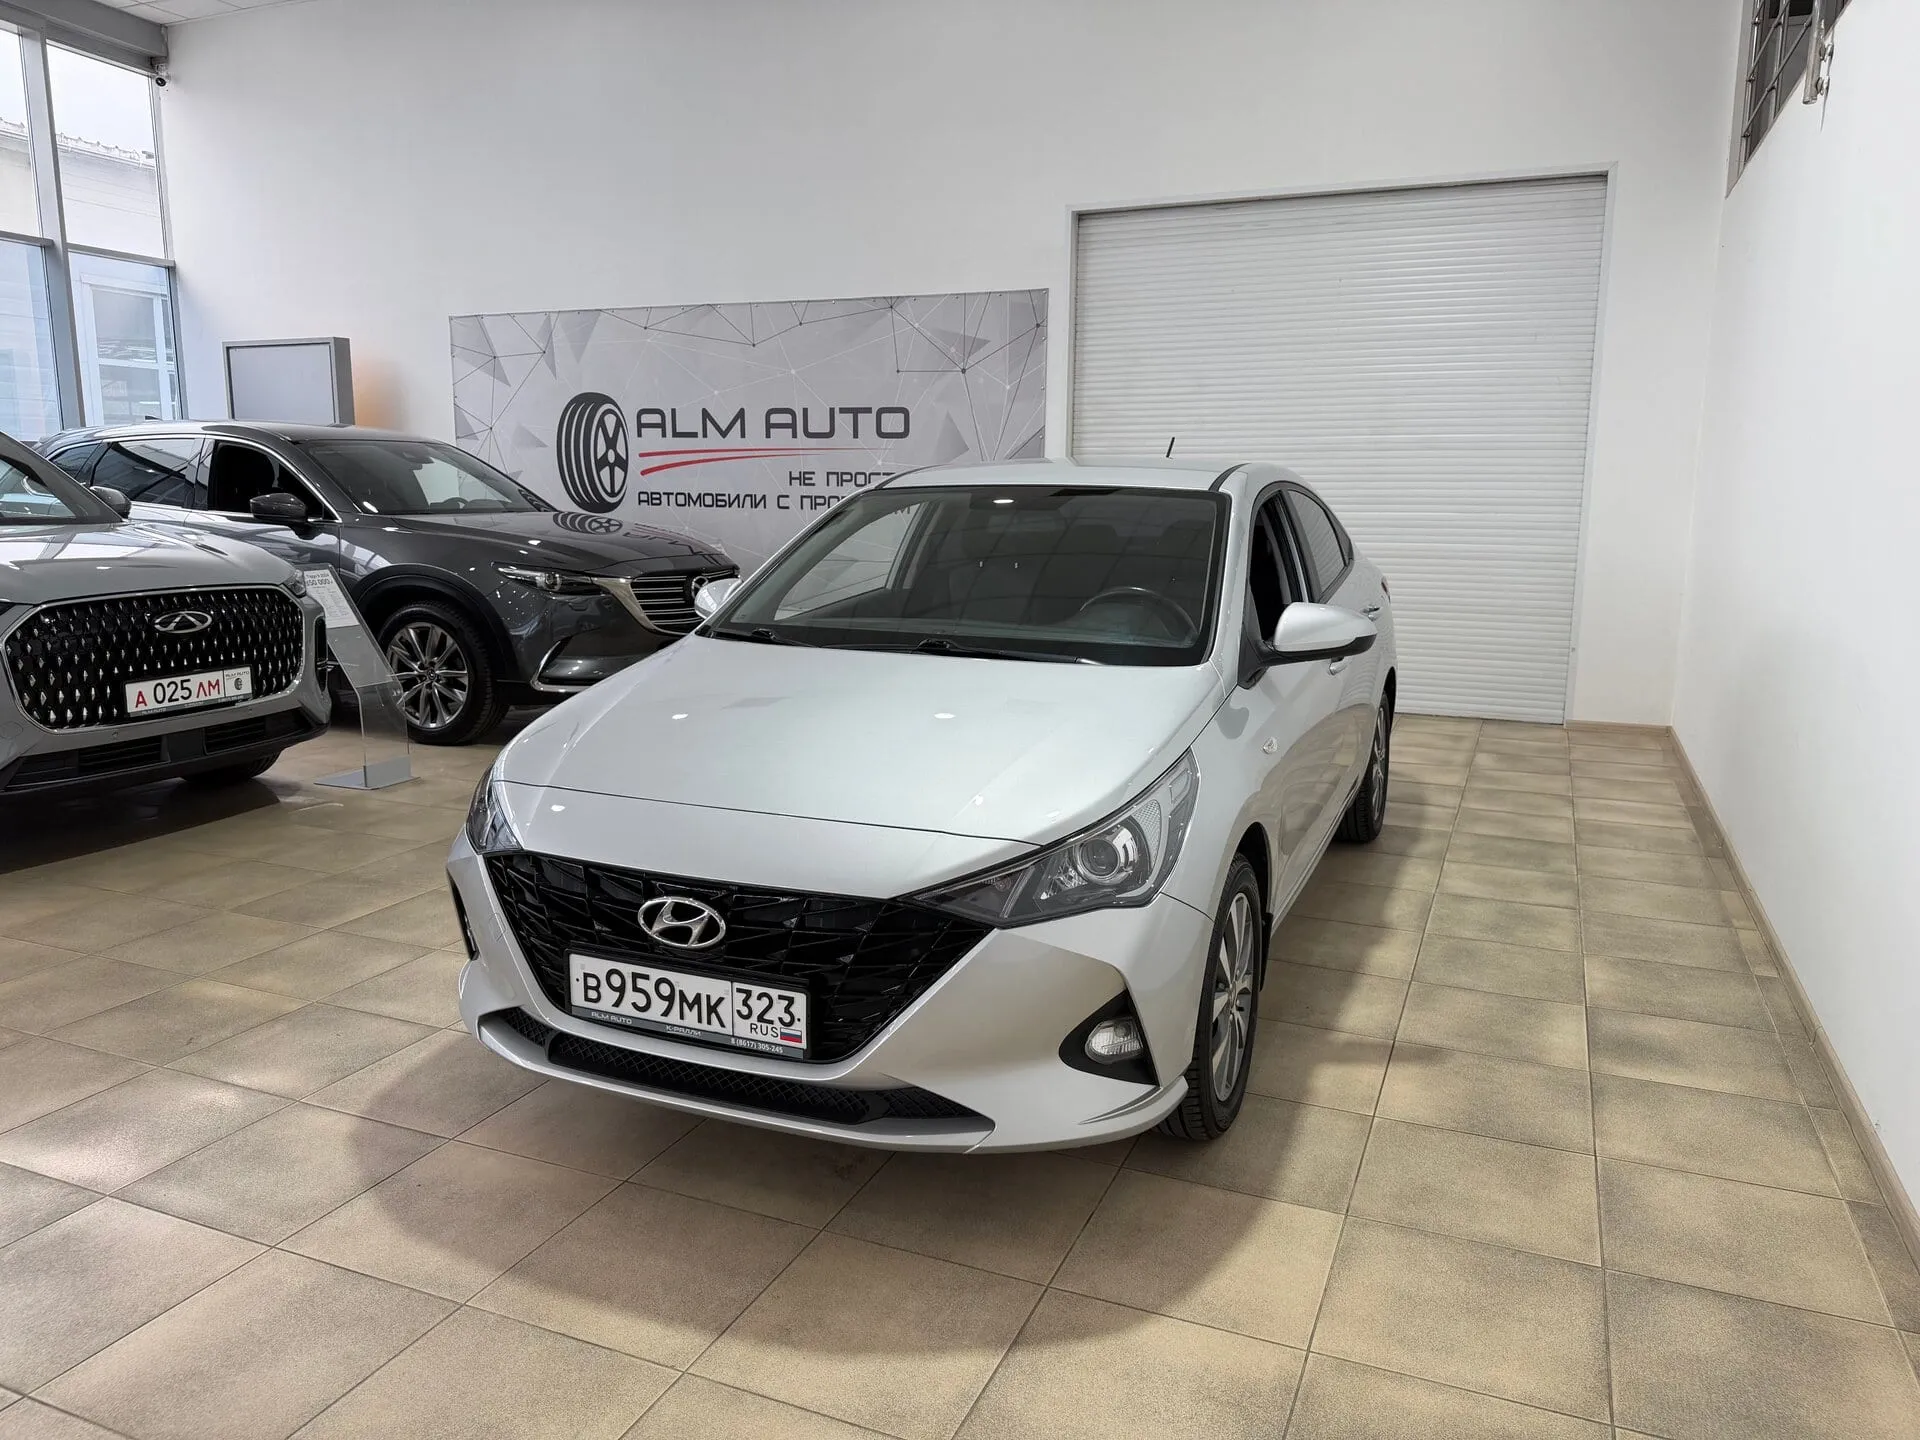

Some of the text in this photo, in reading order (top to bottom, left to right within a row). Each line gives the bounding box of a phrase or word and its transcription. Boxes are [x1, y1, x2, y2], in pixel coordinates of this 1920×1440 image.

[636, 406, 910, 440] ALM AUTO
[789, 471, 815, 487] НЕ
[638, 491, 767, 510] АВТОМОБИЛИ
[776, 495, 790, 509] С
[153, 678, 193, 705] 025
[582, 968, 795, 1029] В959МК 323
[591, 1011, 632, 1025] ALM AUTO
[749, 1022, 779, 1039] RUS
